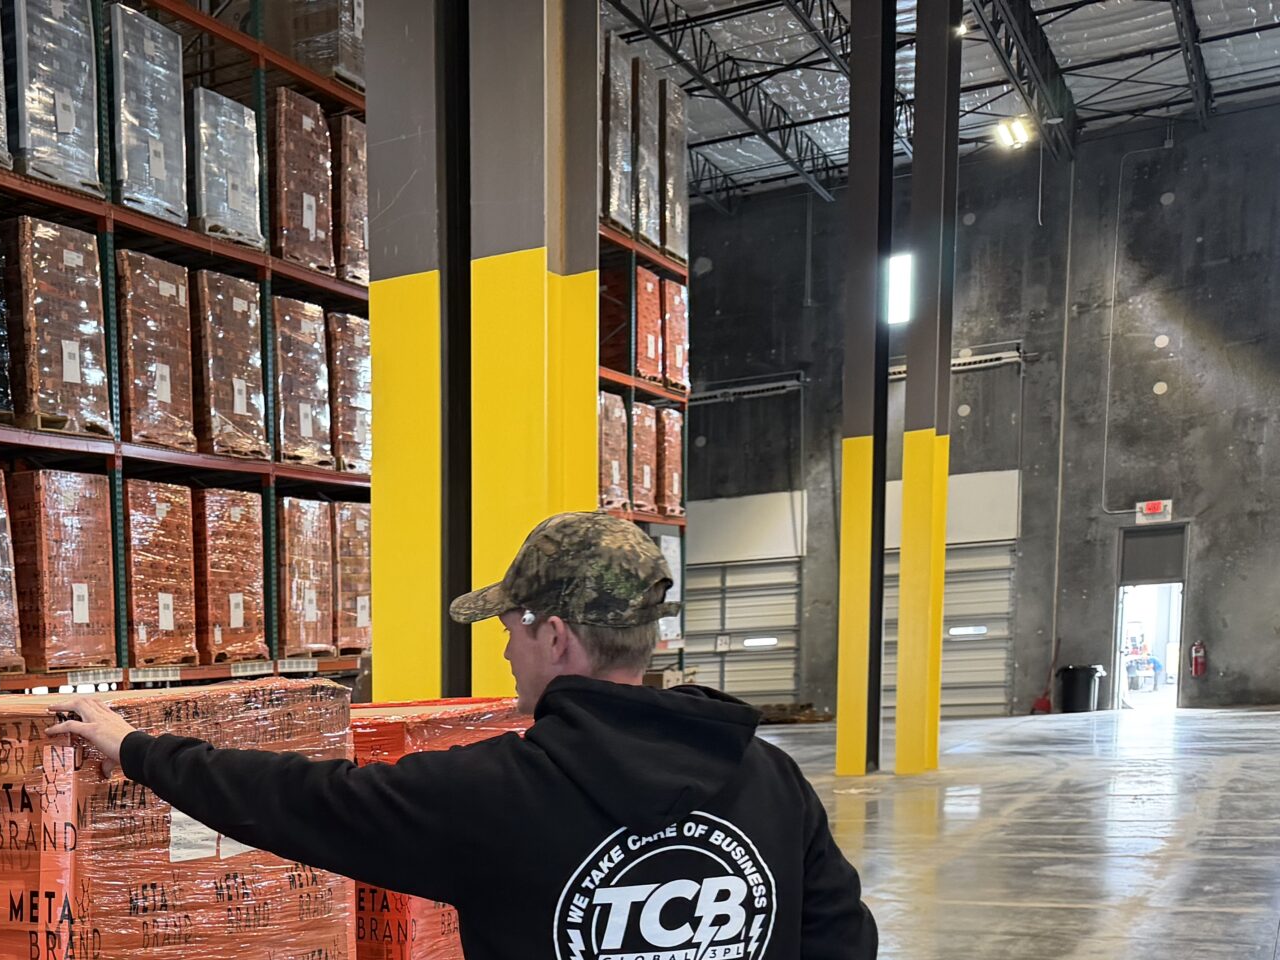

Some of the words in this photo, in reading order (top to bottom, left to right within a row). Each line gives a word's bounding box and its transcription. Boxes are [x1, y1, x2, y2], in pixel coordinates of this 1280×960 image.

[567, 894, 590, 923] WE
[582, 845, 625, 890] TAKE
[683, 822, 708, 838] OF
[709, 830, 767, 909] BUSINESS
[10, 890, 74, 924] META
[358, 888, 390, 912] ETA
[592, 875, 748, 950] TCB
[358, 918, 417, 943] BRAND
[709, 944, 743, 959] 3PL
